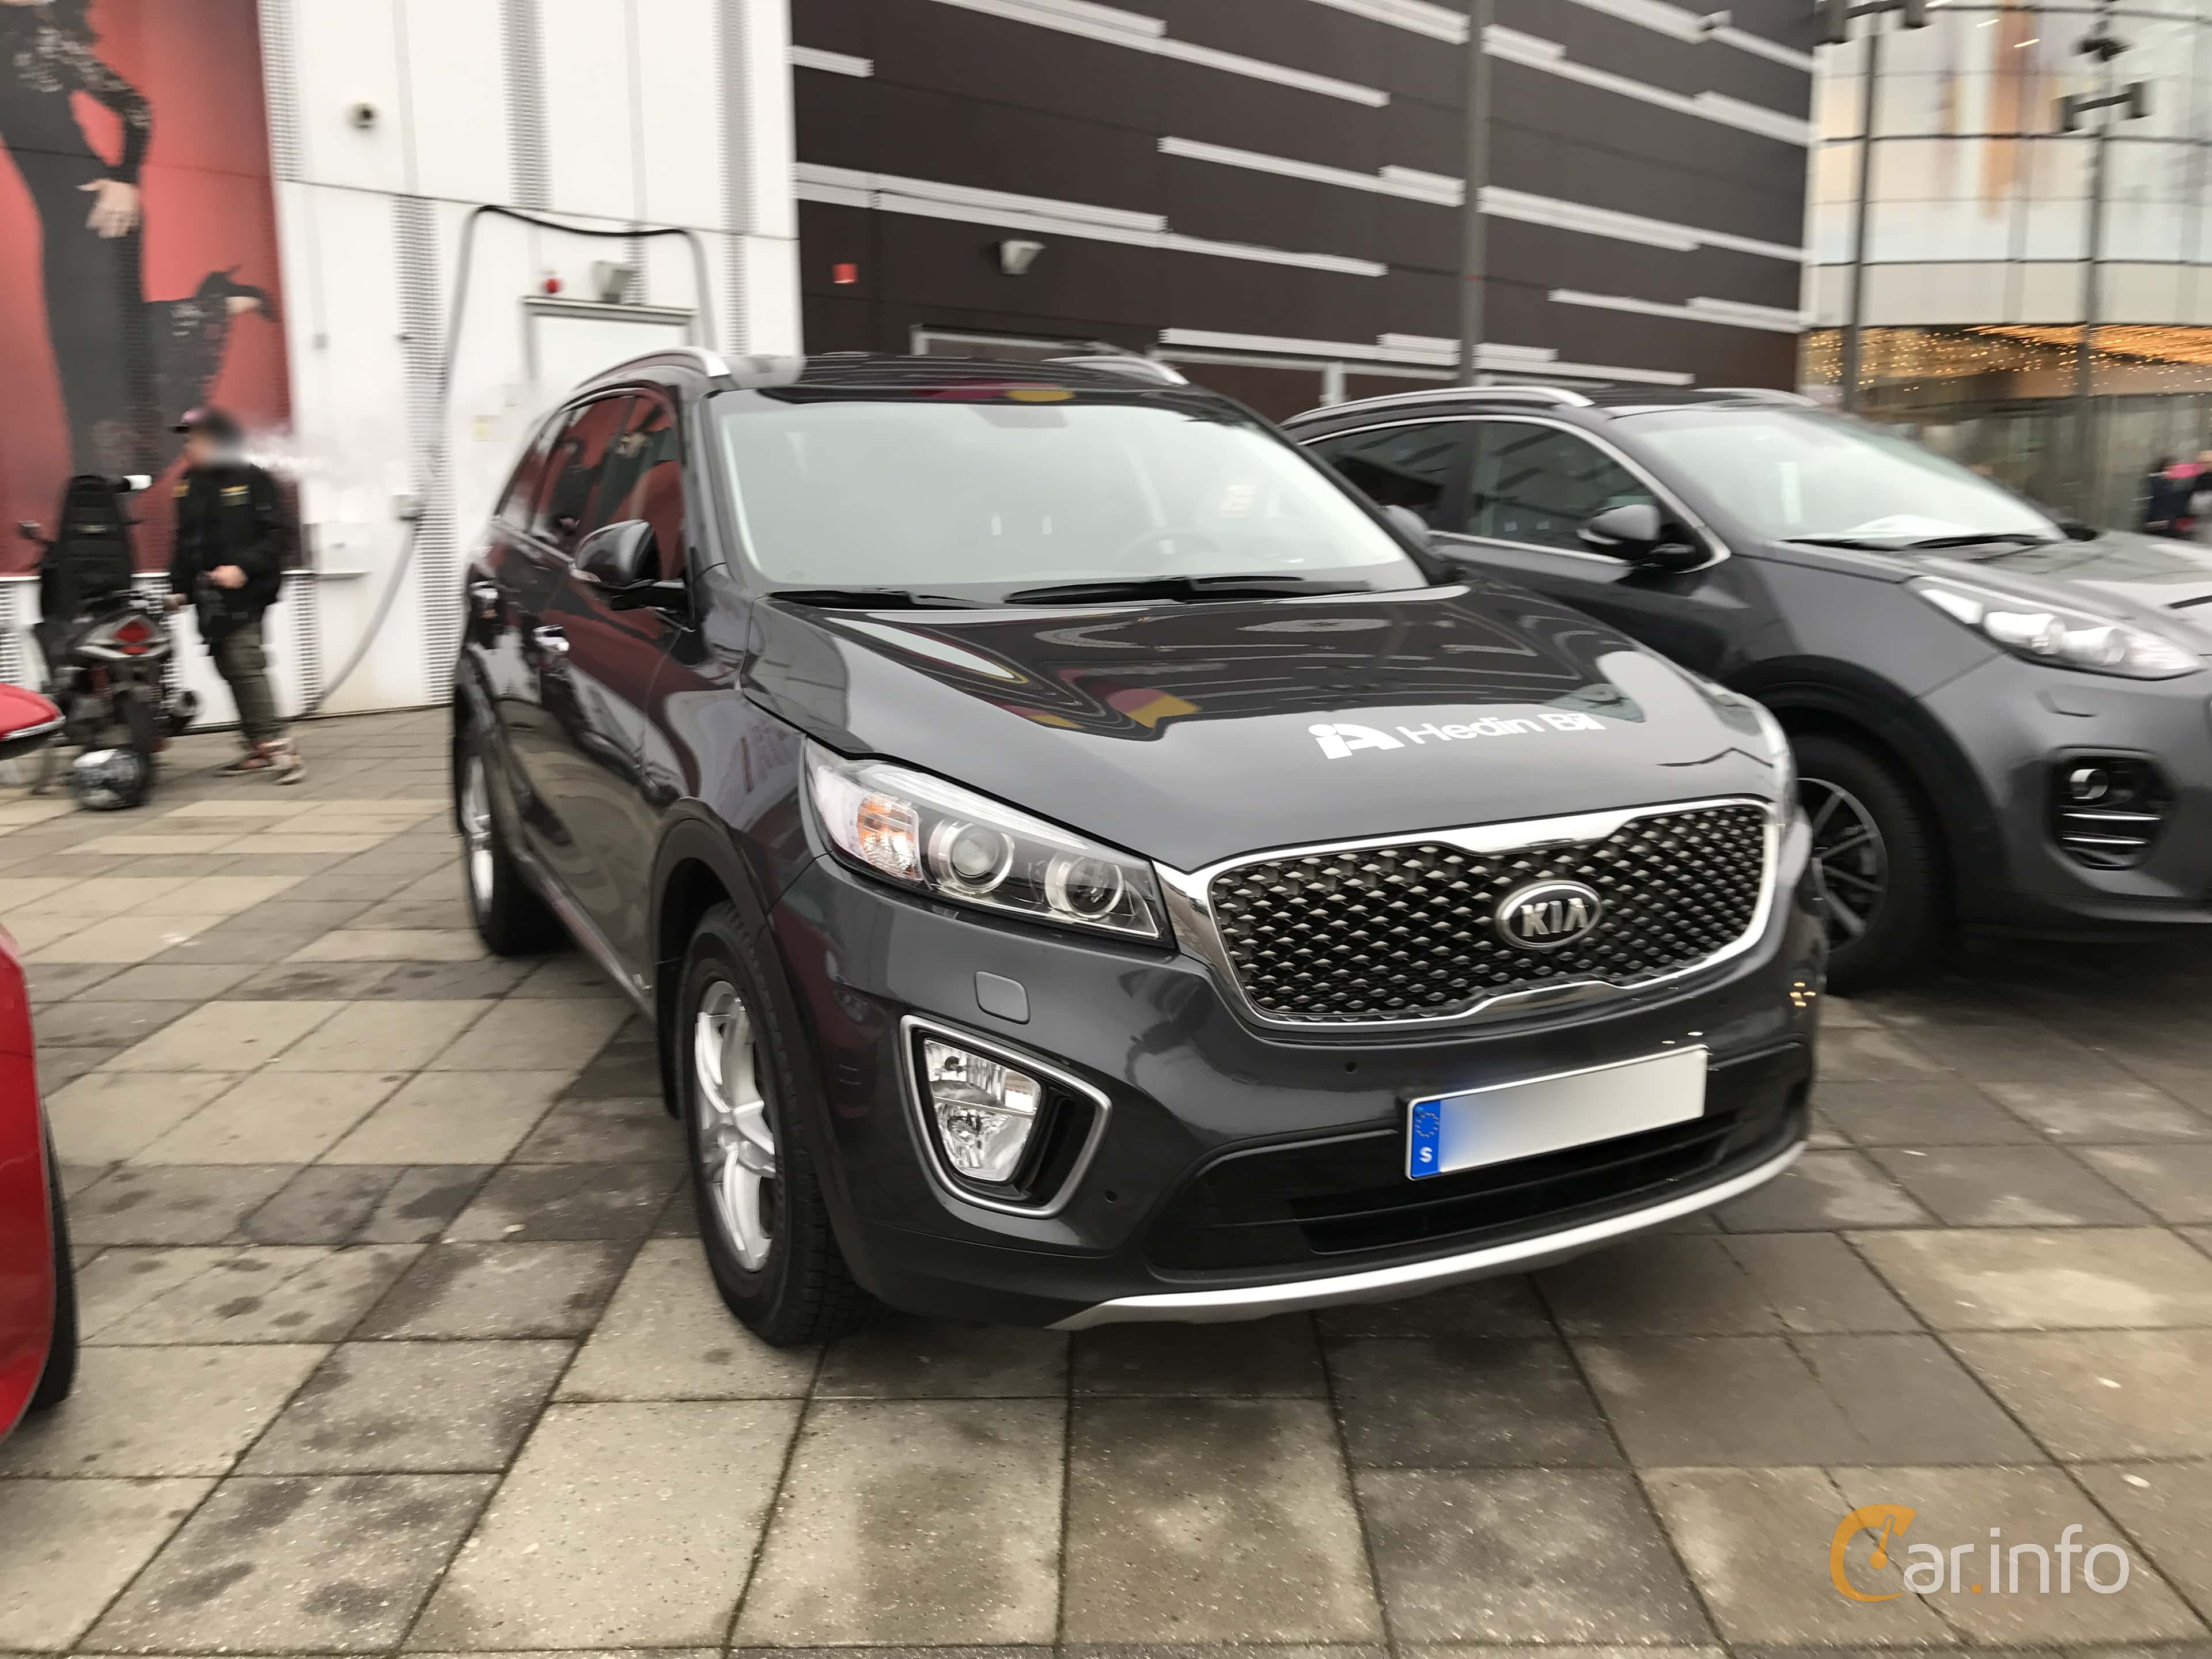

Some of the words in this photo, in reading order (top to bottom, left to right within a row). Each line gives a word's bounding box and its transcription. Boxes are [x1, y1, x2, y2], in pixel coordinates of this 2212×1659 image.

[1395, 717, 1546, 745] Hedin
[1520, 897, 1589, 937] KIA
[1419, 1146, 1433, 1163] S
